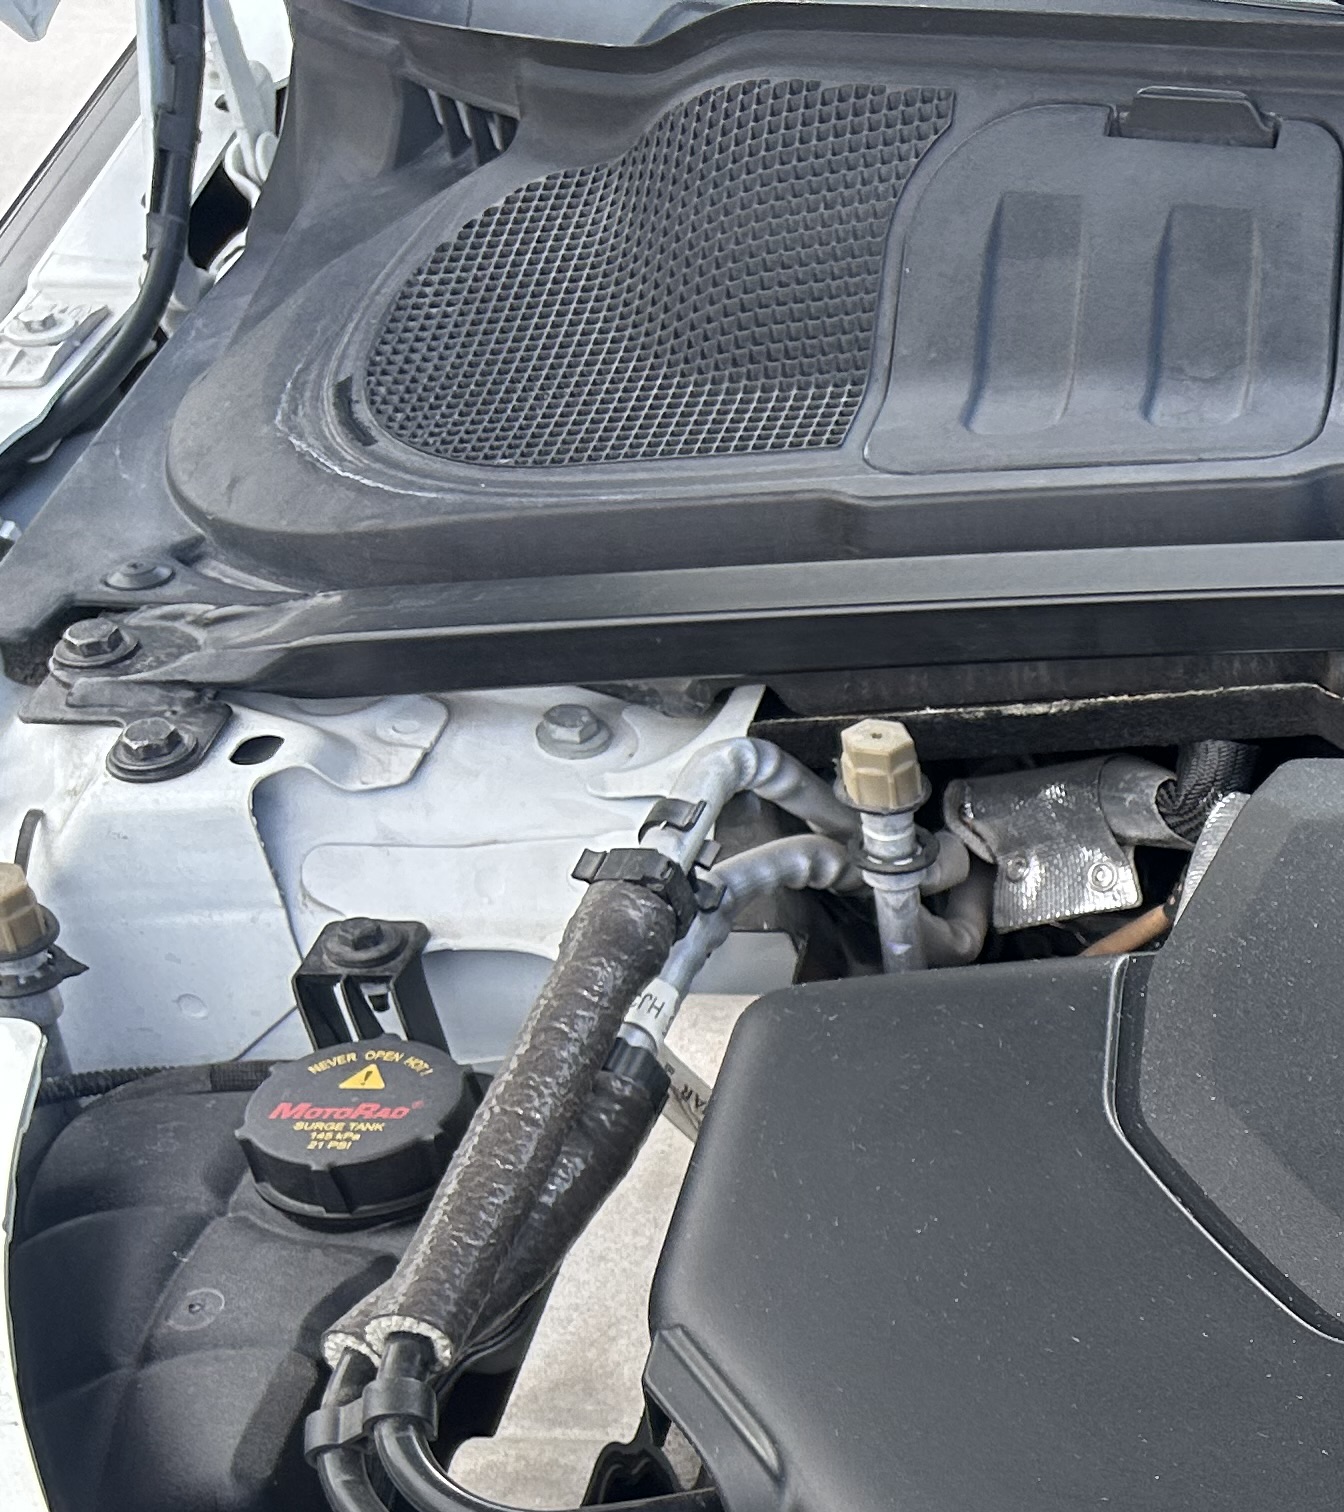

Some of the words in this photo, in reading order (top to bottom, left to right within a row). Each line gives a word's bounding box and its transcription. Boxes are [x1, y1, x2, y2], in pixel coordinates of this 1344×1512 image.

[307, 1052, 358, 1075] NEVER
[364, 1050, 404, 1062] OPEN
[293, 1121, 346, 1131] SURGE
[350, 1121, 386, 1132] TANK
[307, 1141, 323, 1150] 21
[327, 1141, 353, 1150] PSI
